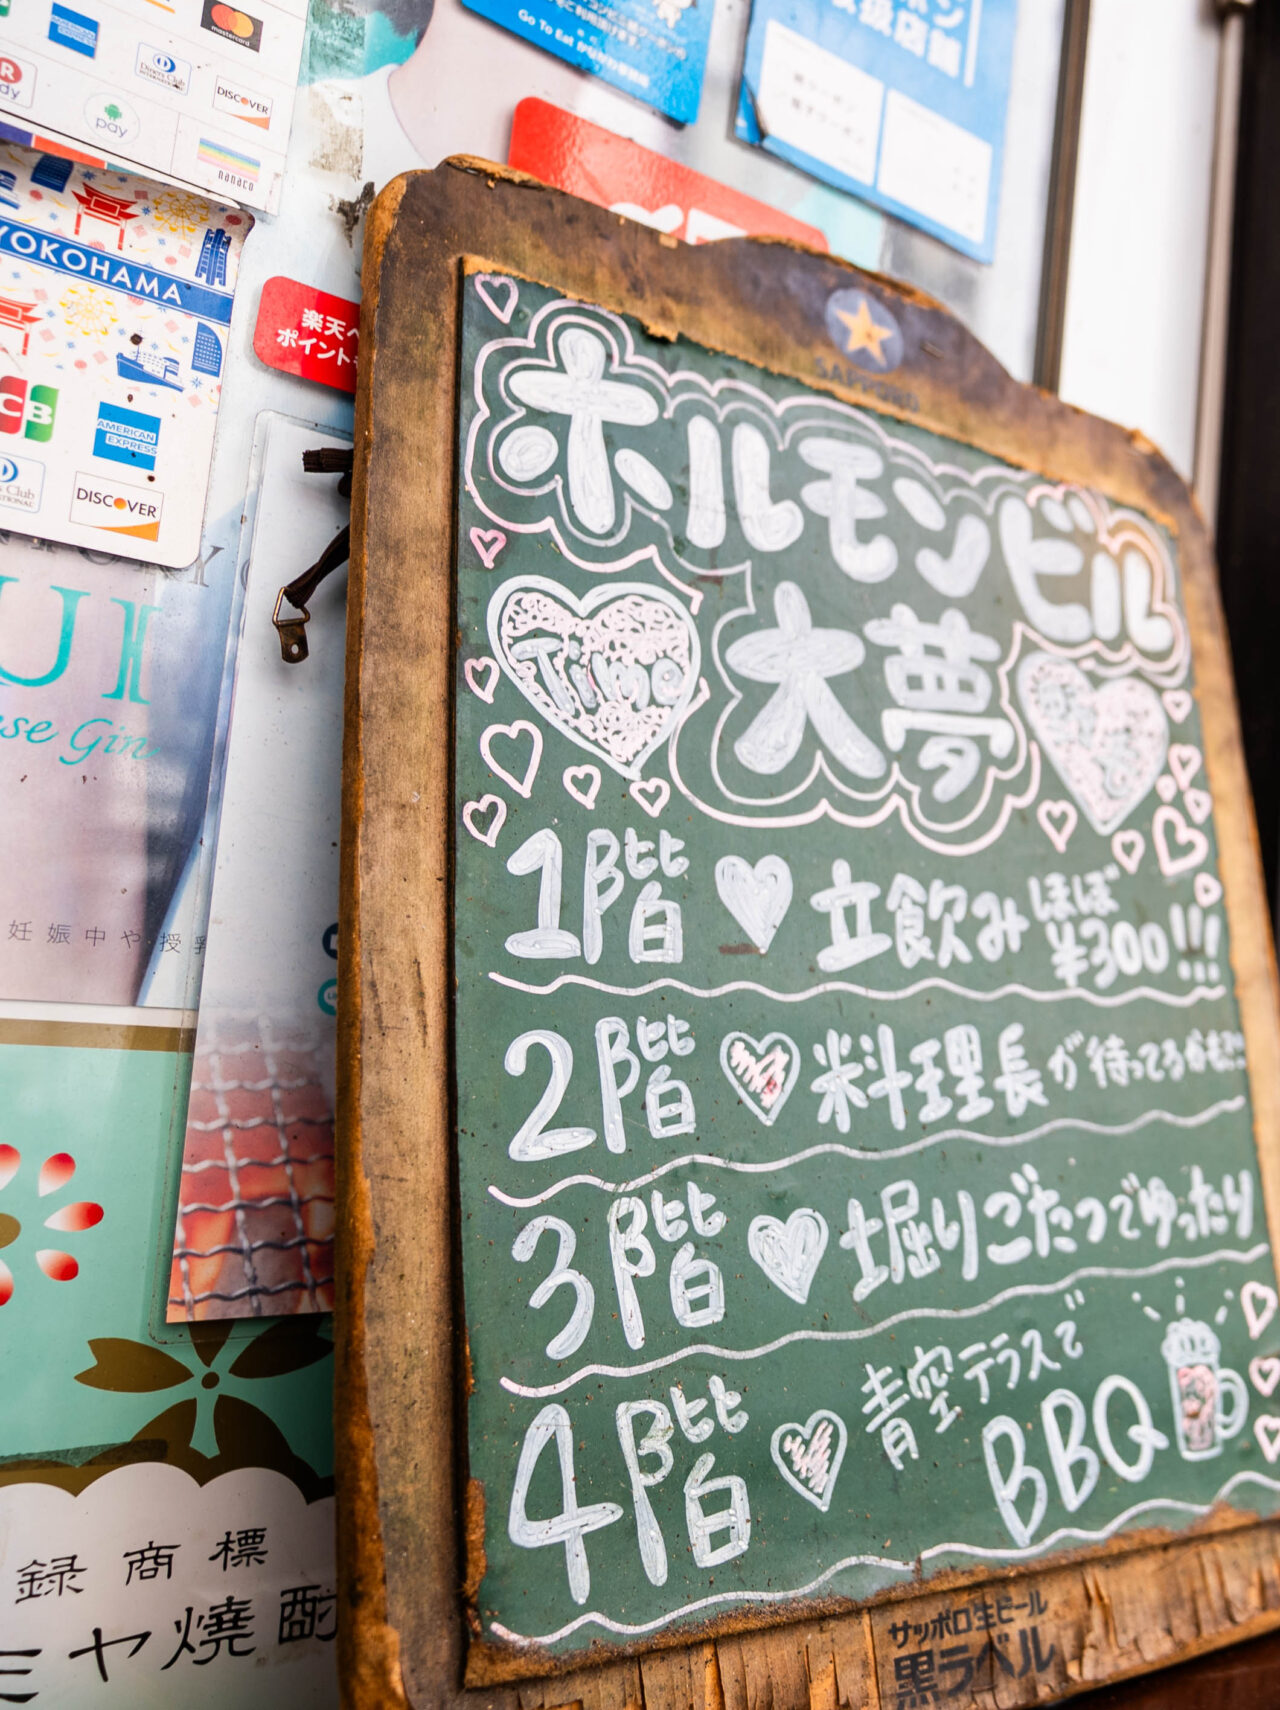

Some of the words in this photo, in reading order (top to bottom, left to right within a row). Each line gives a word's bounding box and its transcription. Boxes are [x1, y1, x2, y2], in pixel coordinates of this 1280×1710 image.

[211, 25, 250, 47] mastercard
[518, 9, 536, 26] Go
[539, 19, 553, 35] To
[555, 29, 574, 47] Eat
[96, 117, 128, 138] pay
[217, 86, 269, 115] DISCOVER
[217, 169, 255, 192] nanaco
[276, 328, 358, 366] ポイント
[815, 356, 920, 414] SAPPORO
[97, 418, 155, 442] AMERICAN
[107, 436, 157, 456] EXPRESS
[76, 487, 156, 519] DISCOVER
[498, 327, 1174, 652] ホルモンビル
[725, 580, 1015, 802] 大夢
[59, 718, 160, 766] Gin
[504, 827, 690, 965] 1階
[810, 857, 1030, 974] 立飲み
[1027, 863, 1121, 922] ほぼ
[504, 1014, 697, 1162] 2階
[511, 1181, 727, 1360] 3階
[508, 1374, 750, 1605] 4階
[861, 1288, 1084, 1471] 青空テラスで
[981, 1374, 1170, 1548] BBQ
[15, 1527, 269, 1604] 録商標
[888, 1590, 1048, 1648] サッポロ生ビール
[893, 1625, 1056, 1709] 黒ラベル
